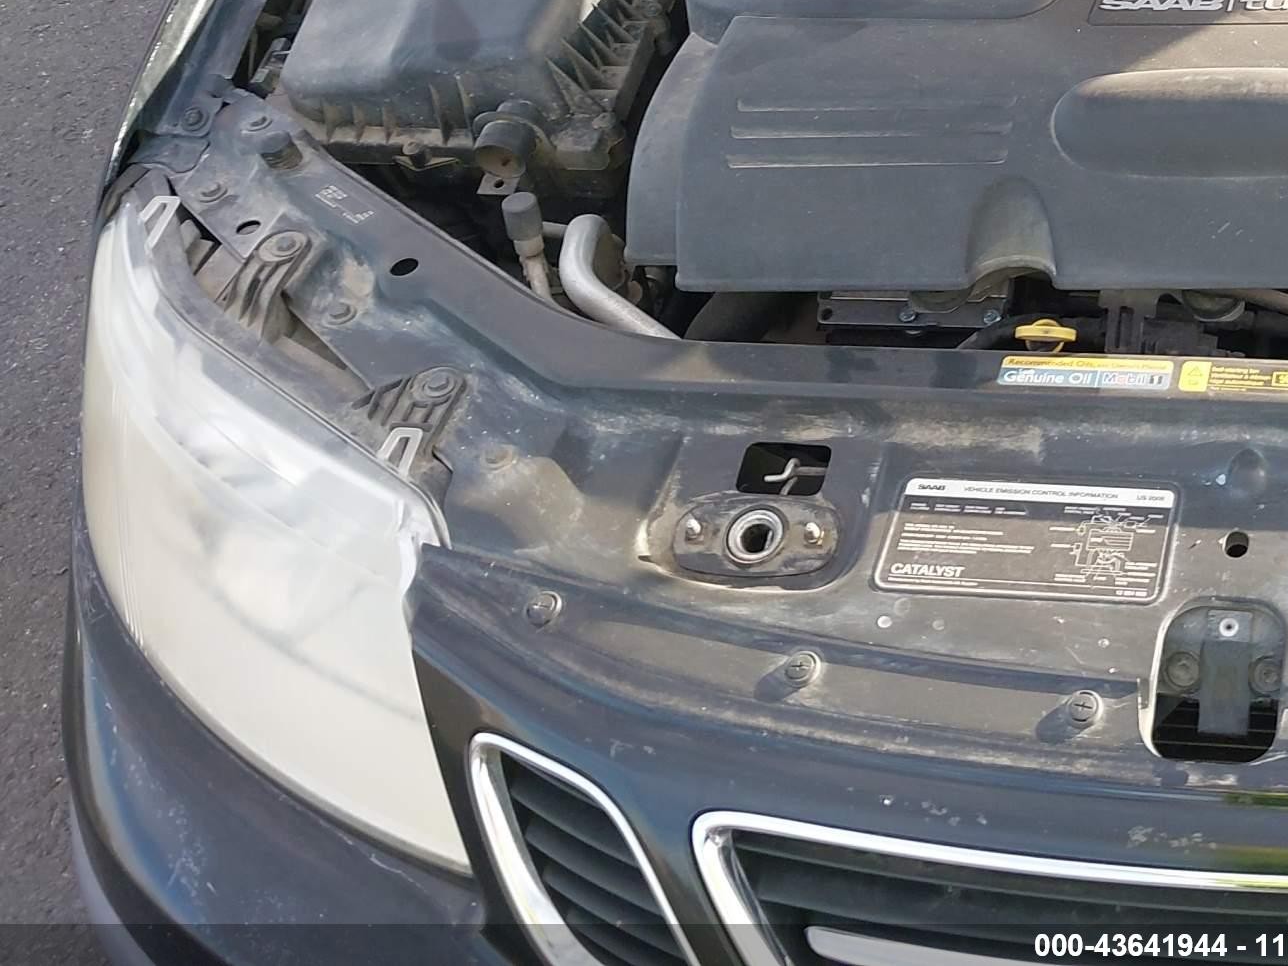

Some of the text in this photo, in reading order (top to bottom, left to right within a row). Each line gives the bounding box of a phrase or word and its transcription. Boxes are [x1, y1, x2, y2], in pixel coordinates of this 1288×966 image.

[1007, 359, 1074, 367] Recommended
[1003, 370, 1065, 384] Genuine
[1068, 372, 1093, 385] Oil
[917, 483, 946, 491] SAAB
[994, 487, 1031, 495] EMISSION
[1031, 489, 1066, 497] CONTROL
[1067, 490, 1119, 499] INFORMATION
[890, 562, 966, 577] CATALYST
